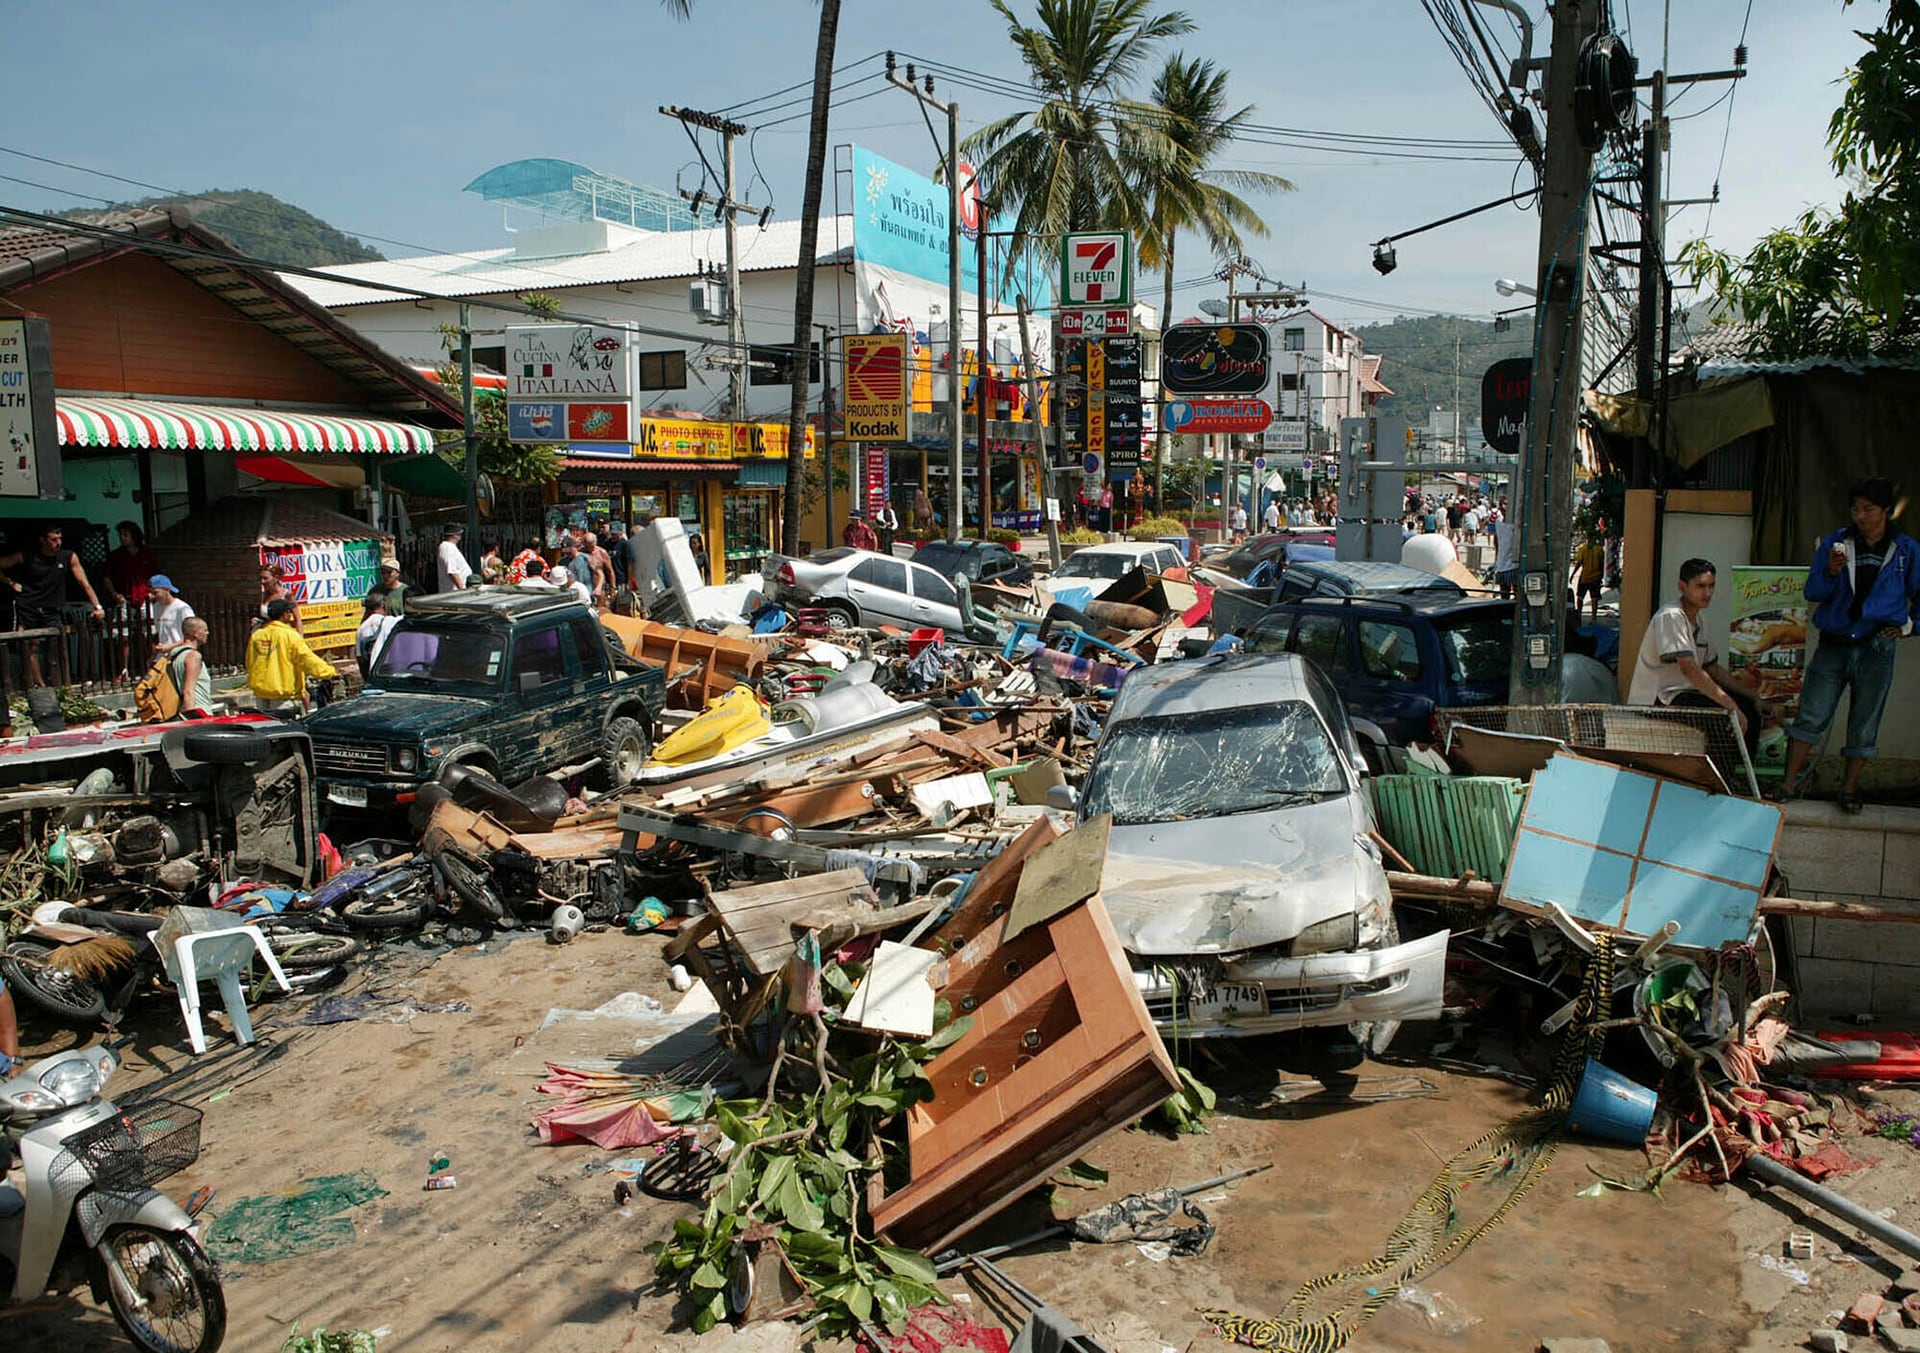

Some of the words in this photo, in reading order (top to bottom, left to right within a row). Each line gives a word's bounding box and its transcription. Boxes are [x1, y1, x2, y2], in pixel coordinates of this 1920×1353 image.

[890, 188, 944, 230] พร้อมใจ
[928, 234, 936, 250] &
[1084, 314, 1104, 331] 24
[528, 334, 546, 351] LA
[513, 348, 561, 363] CUCINA
[2, 371, 24, 387] CUT
[515, 373, 618, 394] ITALIANA
[847, 404, 889, 417] PRODUCTS
[892, 404, 904, 417] BY
[660, 426, 690, 439] PHOTO
[693, 429, 725, 440] EXPRESS
[850, 421, 899, 436] Kodak
[1110, 450, 1138, 459] SPIRO
[280, 575, 378, 601] IZZERIA
[1222, 986, 1259, 1002] 7749
